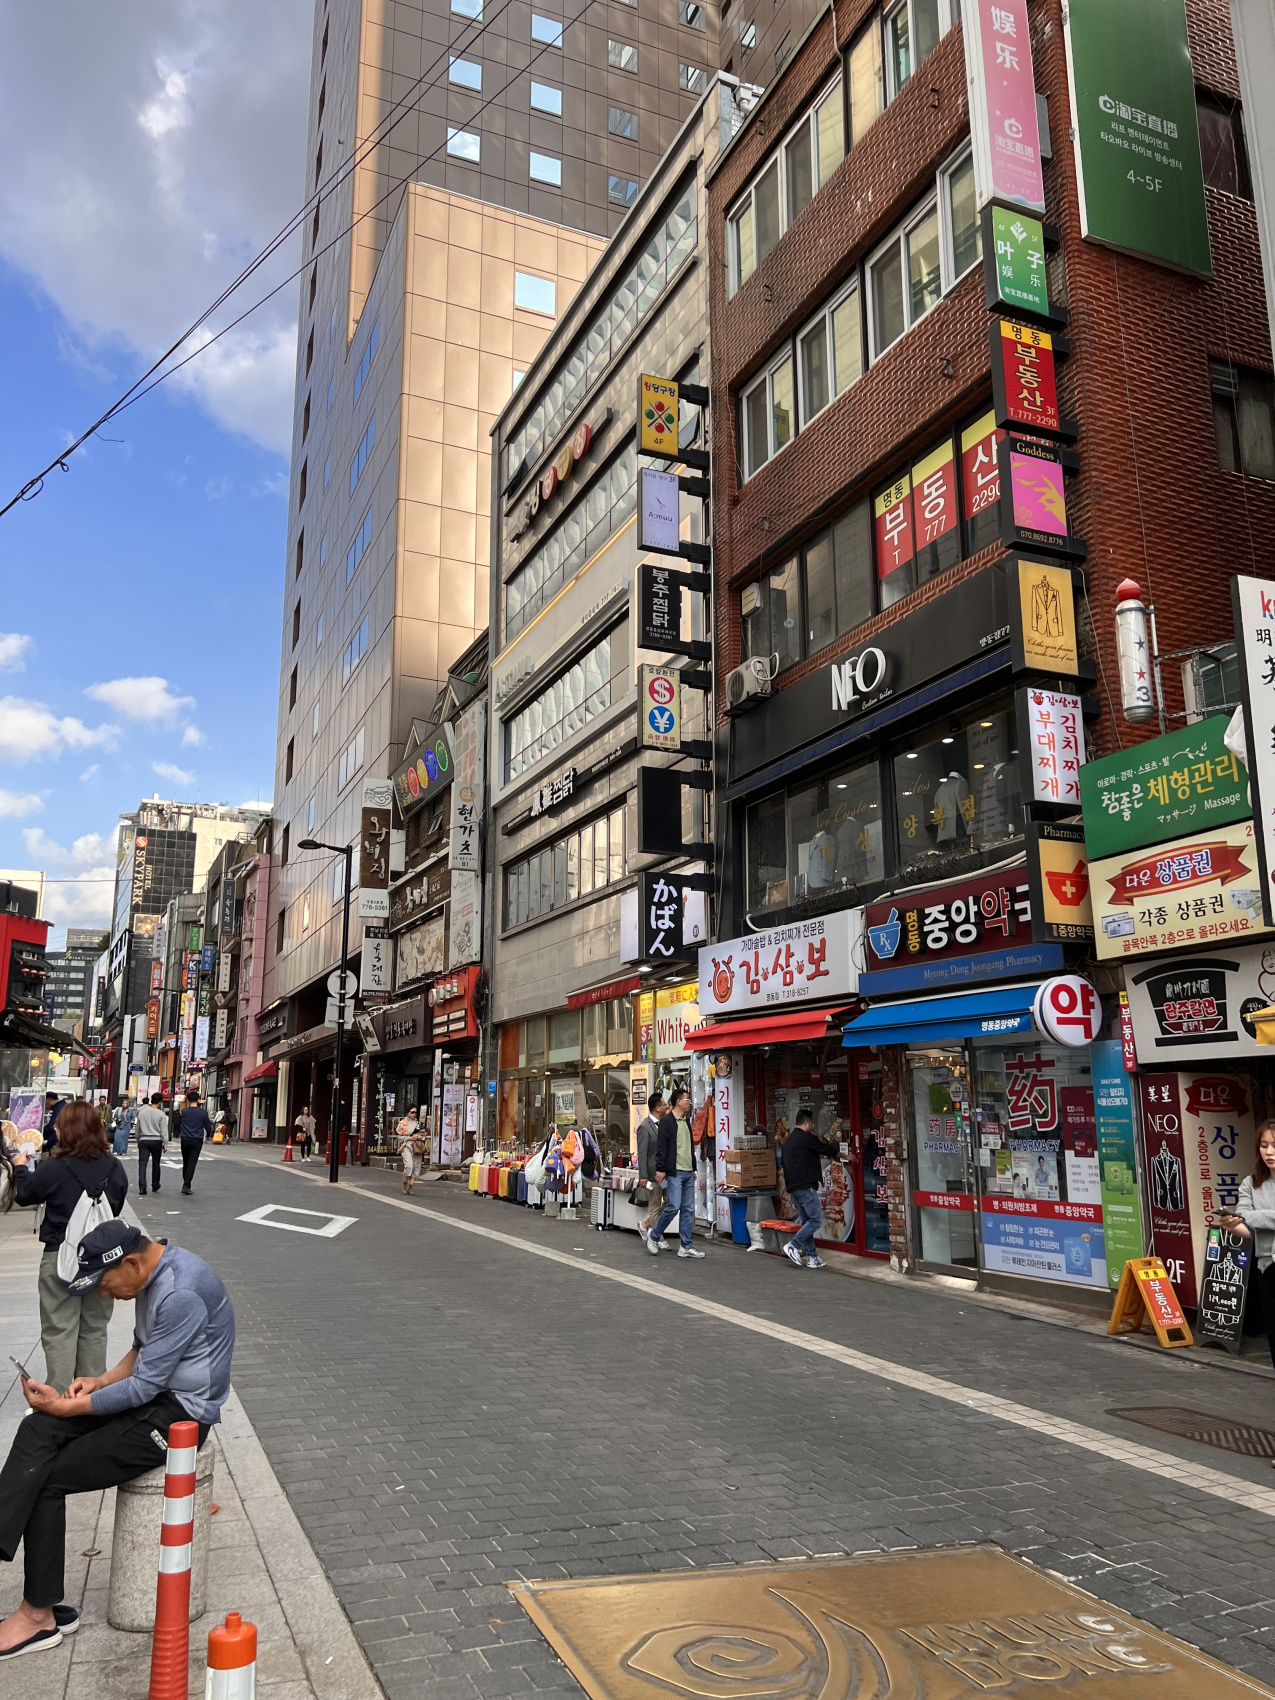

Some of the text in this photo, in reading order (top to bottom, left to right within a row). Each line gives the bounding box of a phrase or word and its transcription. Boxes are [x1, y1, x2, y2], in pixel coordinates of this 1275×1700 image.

[1115, 101, 1178, 138] 淘宝直播
[1127, 169, 1163, 192] 4~5F
[1012, 325, 1041, 346] 명동
[1014, 343, 1044, 412] 부동산
[1009, 407, 1057, 427] T.777-2290
[1046, 405, 1056, 415] 3F
[1016, 441, 1055, 461] Goddess
[883, 481, 903, 508] 명동
[924, 515, 946, 542] 777
[652, 568, 670, 628] 봉추찜닭
[831, 647, 886, 710] NEO
[1136, 685, 1150, 702] 3
[1036, 710, 1059, 799] 부대찌개
[1101, 753, 1239, 822] 참좋은 체형관리
[1204, 792, 1241, 811] Massage
[1157, 804, 1196, 824] マッサージ
[132, 849, 146, 906] SKYPARK
[145, 865, 153, 890] HOTEL
[1125, 850, 1212, 887] 다온 상품권
[649, 878, 678, 957] かばん
[1139, 894, 1224, 927] 각종 상품권
[741, 936, 766, 952] 가마솥밥
[774, 927, 800, 945] 김치찌개
[802, 920, 824, 938] 전문점
[906, 909, 921, 953] 명동
[1122, 918, 1254, 953] 골목안쪽 2층으로 올라오세요.
[923, 953, 1043, 980] Myeong Dong Joongang Pharmacy
[1050, 983, 1095, 1039] 약
[657, 1016, 690, 1046] White
[1121, 1007, 1134, 1058] 부동산
[1005, 1053, 1058, 1131] 药
[1200, 1085, 1231, 1105] 다온
[718, 1086, 730, 1162] 김치찌
[929, 1118, 955, 1137] 药房
[1148, 1112, 1178, 1133] NEO
[924, 1142, 960, 1153] PHARMAC
[1009, 1140, 1060, 1152] PHARMACY
[1197, 1126, 1214, 1228] 2층으로 올라오
[1211, 1124, 1241, 1206] 상품
[938, 1194, 961, 1207] 중앙약국
[1065, 1205, 1095, 1218] 중앙약국
[1220, 1228, 1243, 1247] NO
[1167, 1258, 1185, 1284] 2F
[1149, 1280, 1173, 1318] 부동산
[900, 1612, 1134, 1656] MYUNG
[943, 1641, 1168, 1690] DONG
